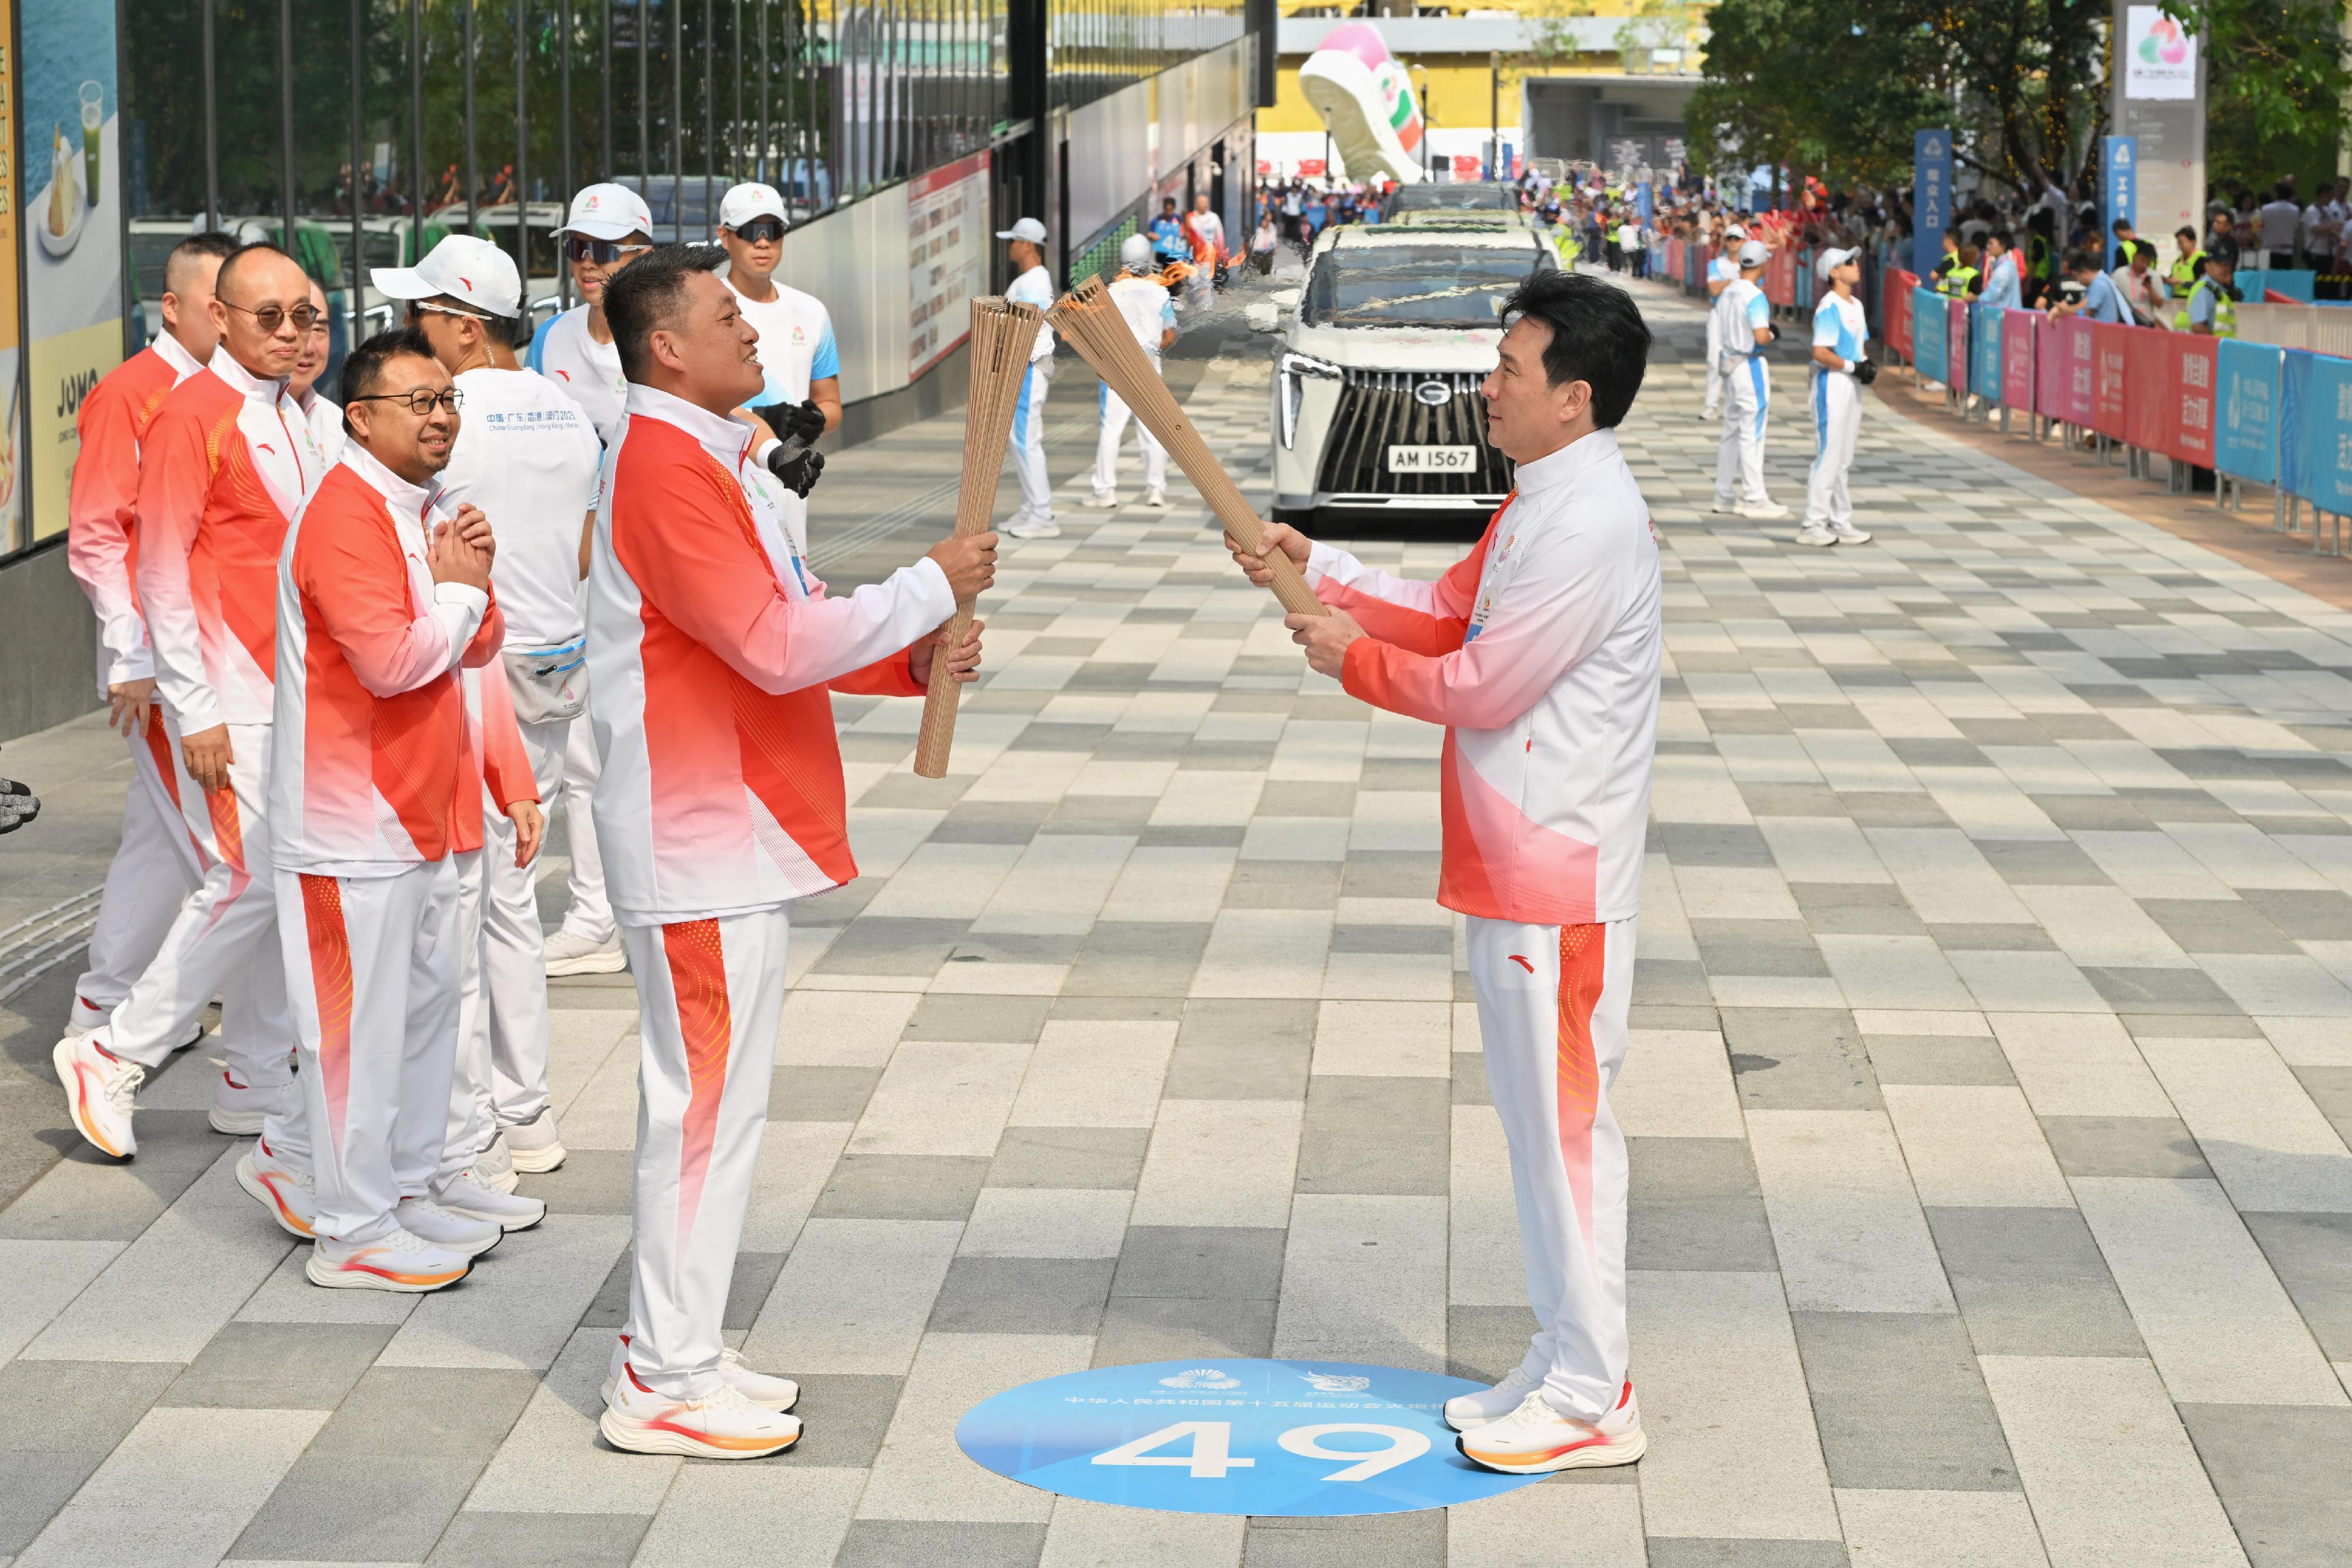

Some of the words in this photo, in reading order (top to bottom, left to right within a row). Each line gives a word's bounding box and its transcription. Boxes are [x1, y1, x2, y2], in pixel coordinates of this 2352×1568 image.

[1396, 452, 1419, 466] AM
[1428, 452, 1469, 466] 1567
[1091, 1421, 1432, 1482] 49
